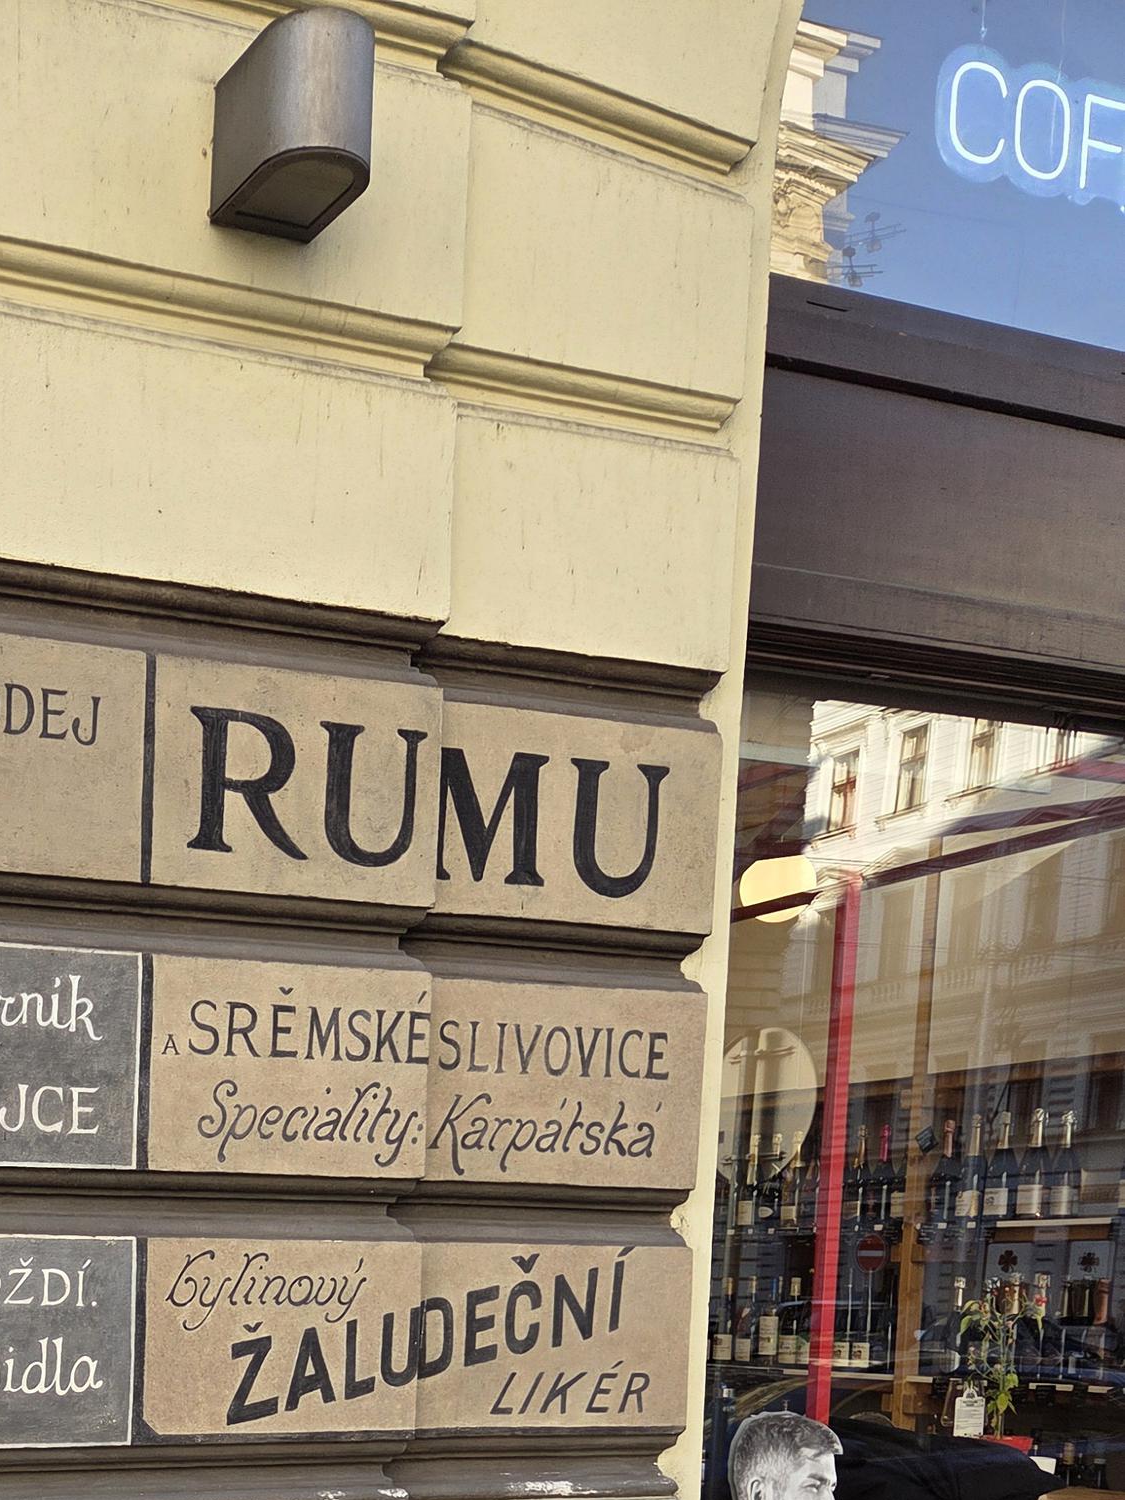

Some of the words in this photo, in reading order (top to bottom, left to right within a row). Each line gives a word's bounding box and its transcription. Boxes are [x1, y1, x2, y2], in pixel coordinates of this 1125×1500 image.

[186, 704, 670, 899] RUMU
[161, 1033, 180, 1056] A
[188, 986, 431, 1066] SRĚMSKÉ
[437, 1018, 670, 1081] SLIVOVICE
[197, 1079, 424, 1167] Speciality:
[427, 1093, 663, 1176] Karpátská
[164, 1249, 369, 1331] bylinový
[225, 1246, 635, 1426] ŽALUDEČNÍ
[489, 1361, 651, 1415] LIKÉR
